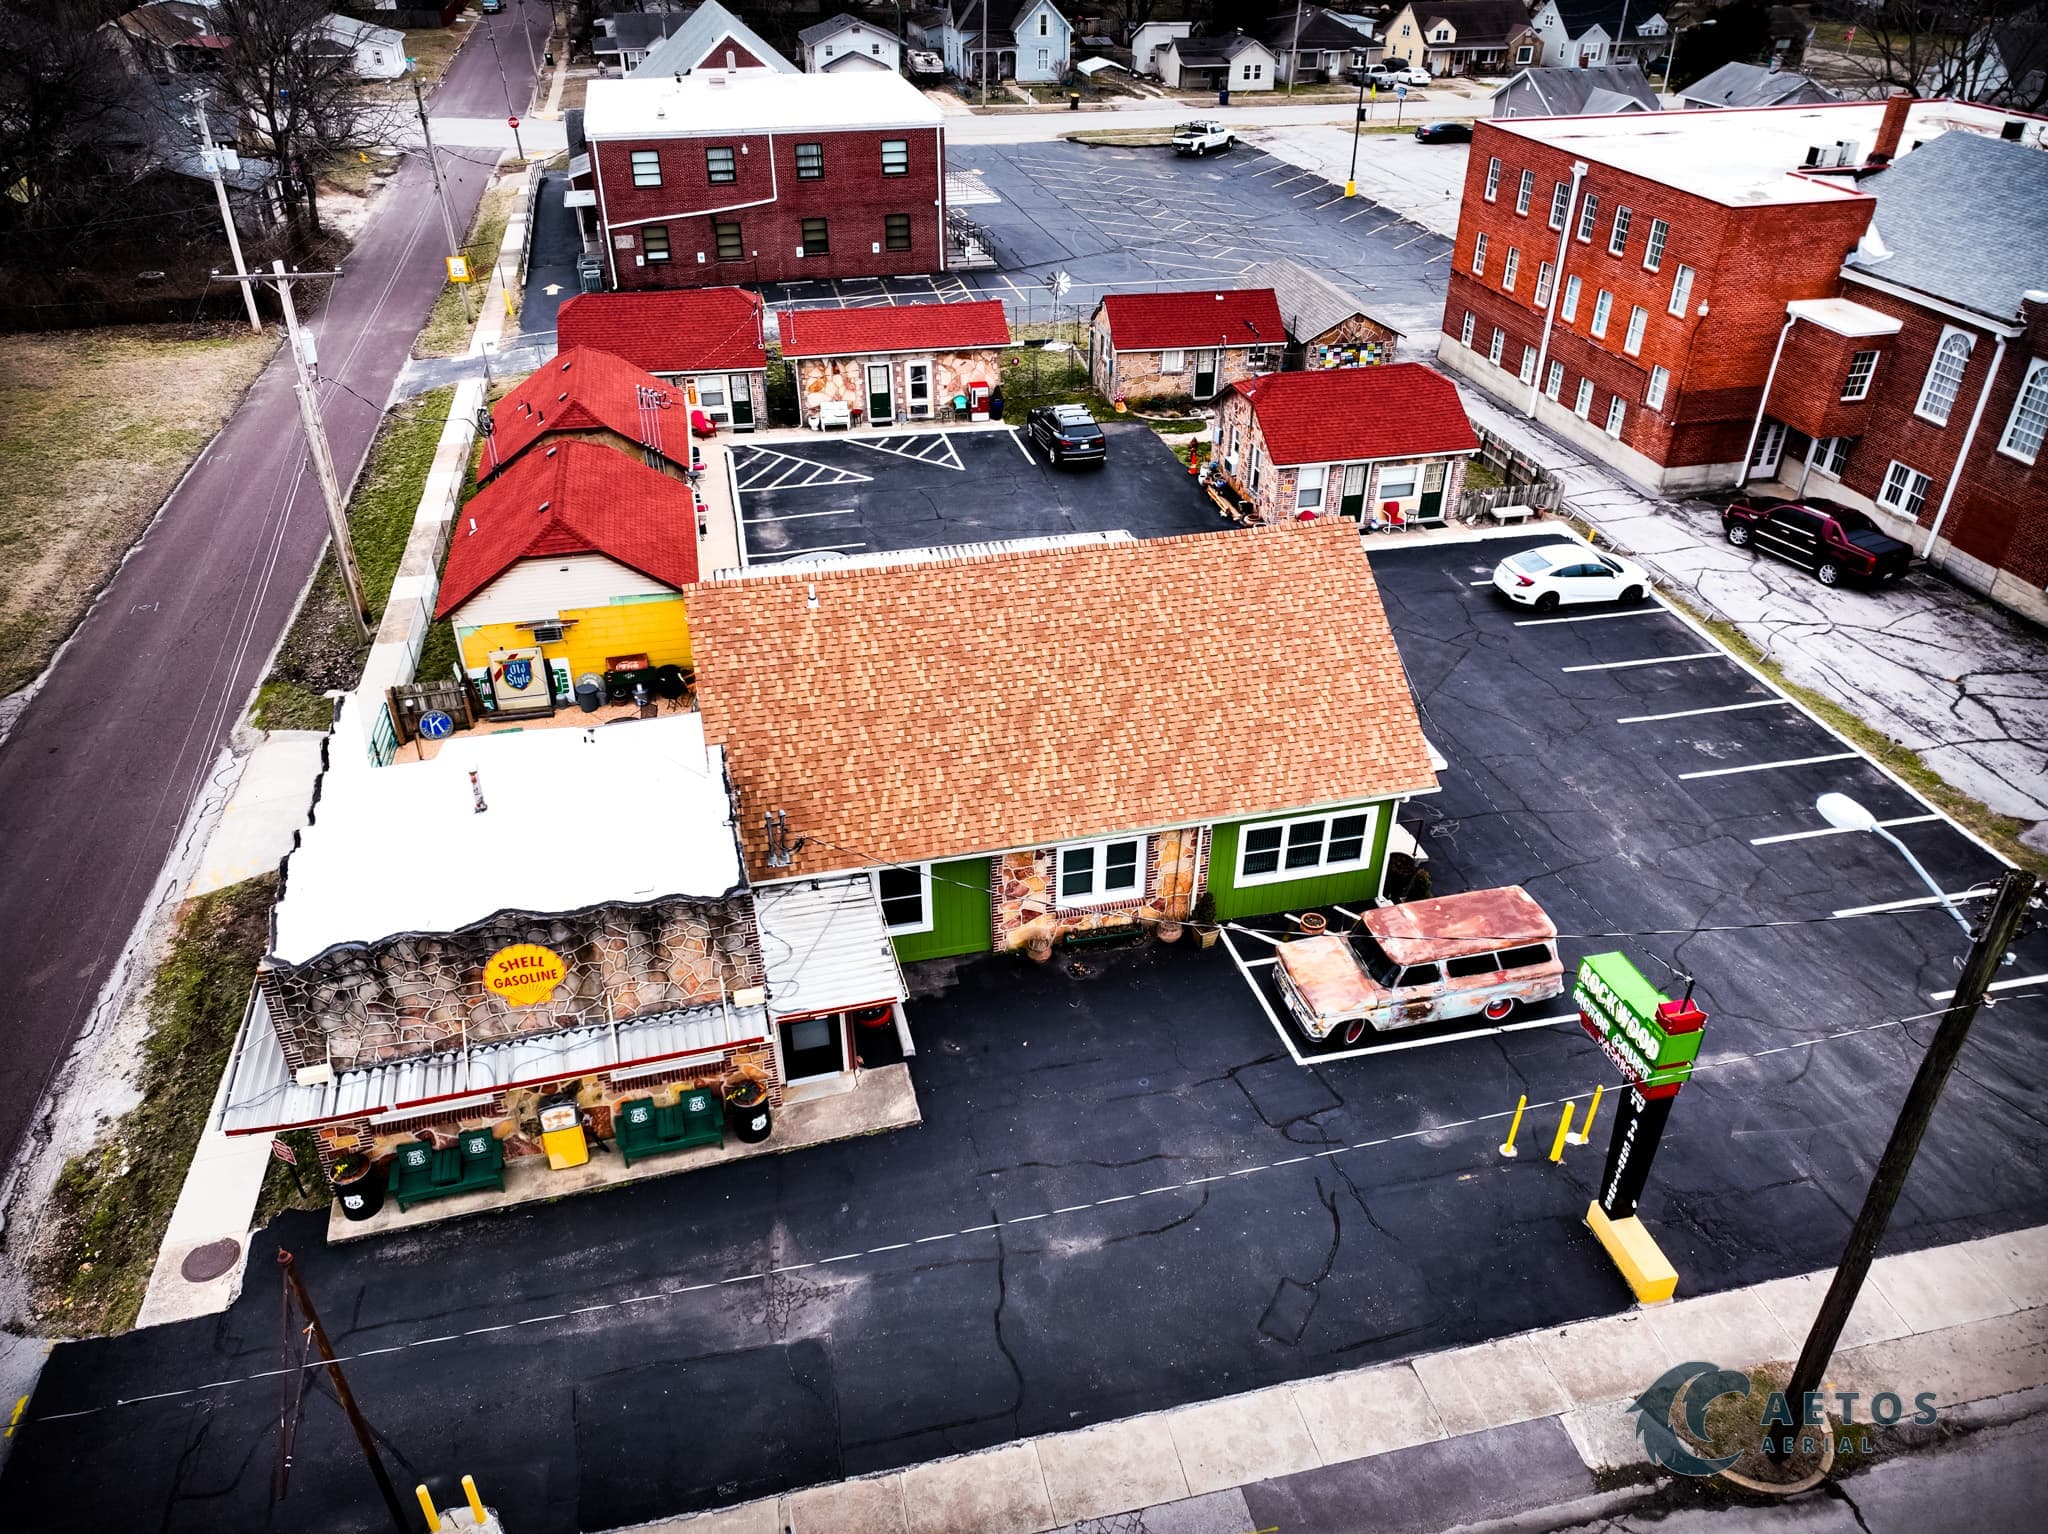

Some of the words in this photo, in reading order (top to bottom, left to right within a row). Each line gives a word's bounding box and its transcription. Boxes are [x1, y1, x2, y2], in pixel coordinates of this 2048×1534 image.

[453, 267, 465, 275] 25
[509, 663, 526, 675] Old
[506, 673, 531, 688] Style
[429, 717, 445, 735] K
[498, 956, 545, 973] SHELL
[493, 969, 558, 989] GASOLINE
[1578, 961, 1660, 1061] ROCKWOOD
[1573, 987, 1611, 1035] MOTOR
[1612, 1033, 1652, 1080] COURT
